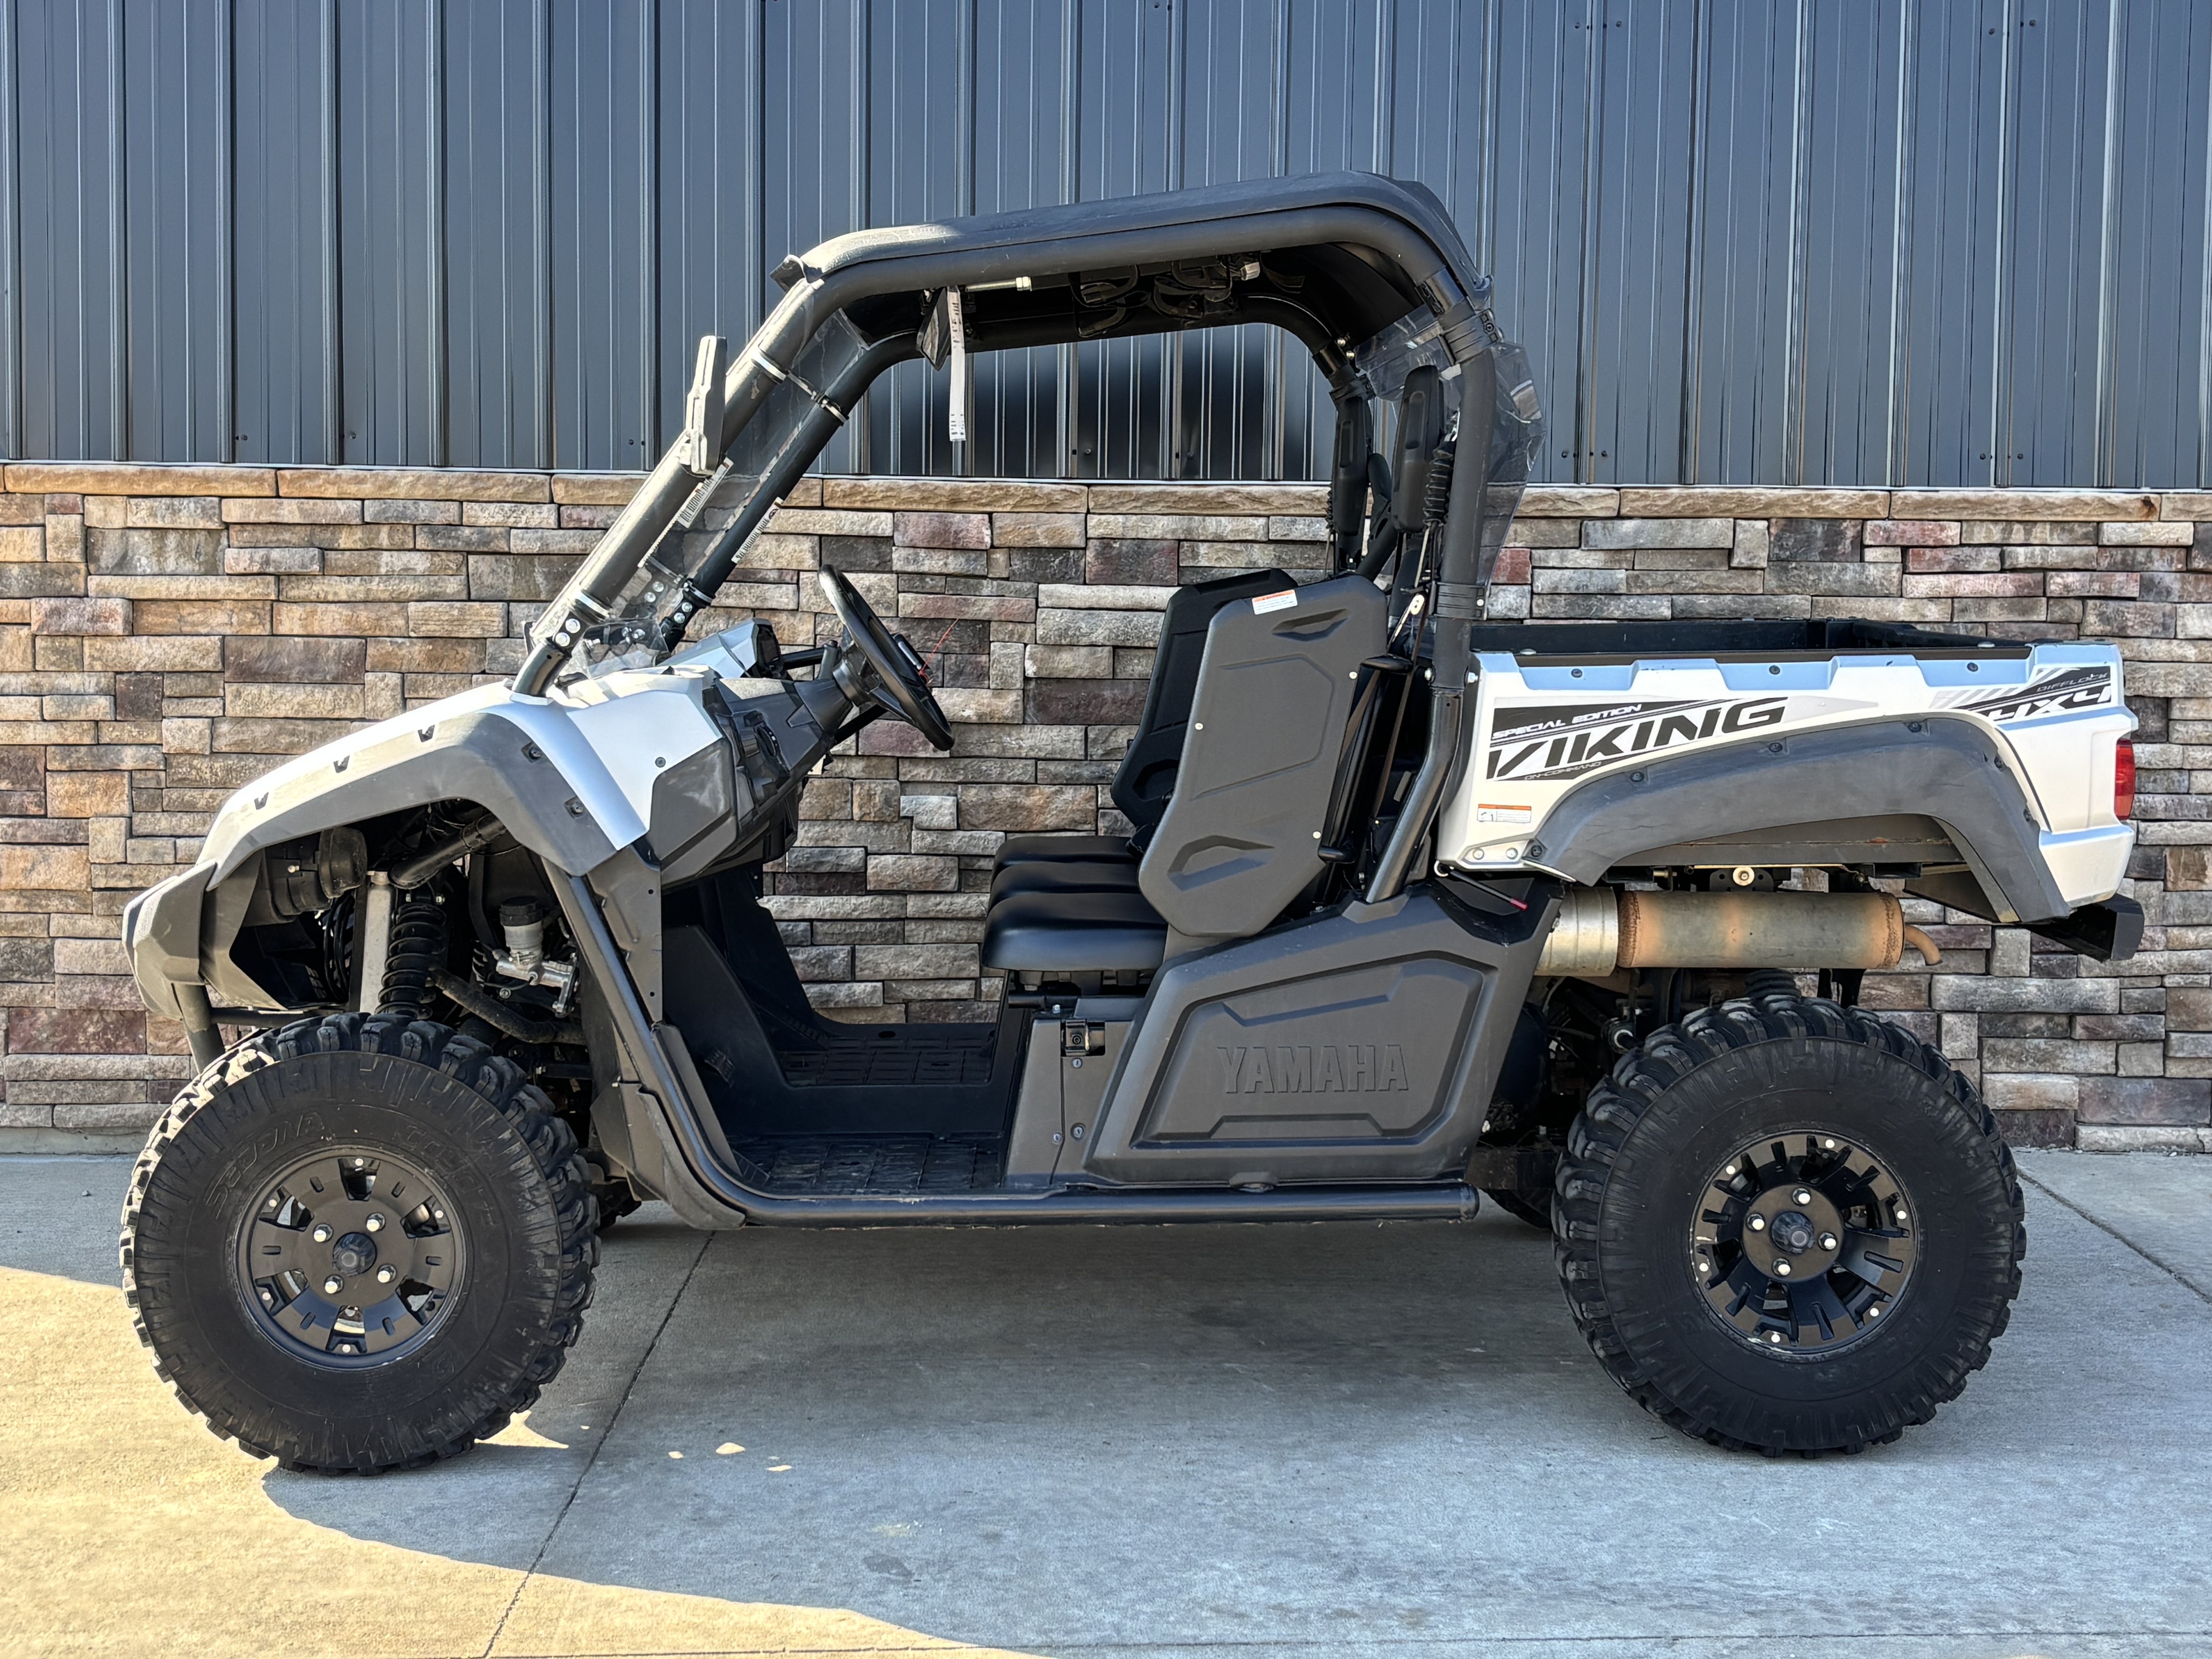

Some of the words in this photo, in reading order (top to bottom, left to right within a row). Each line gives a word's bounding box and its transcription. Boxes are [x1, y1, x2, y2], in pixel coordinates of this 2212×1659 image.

[1486, 697, 1788, 779] VIKING
[1492, 719, 1566, 740] SPECIAL
[1571, 704, 1650, 724] EDITION
[1524, 761, 1602, 780] ON-COMMAND
[1217, 1044, 1409, 1094] YAMAHA
